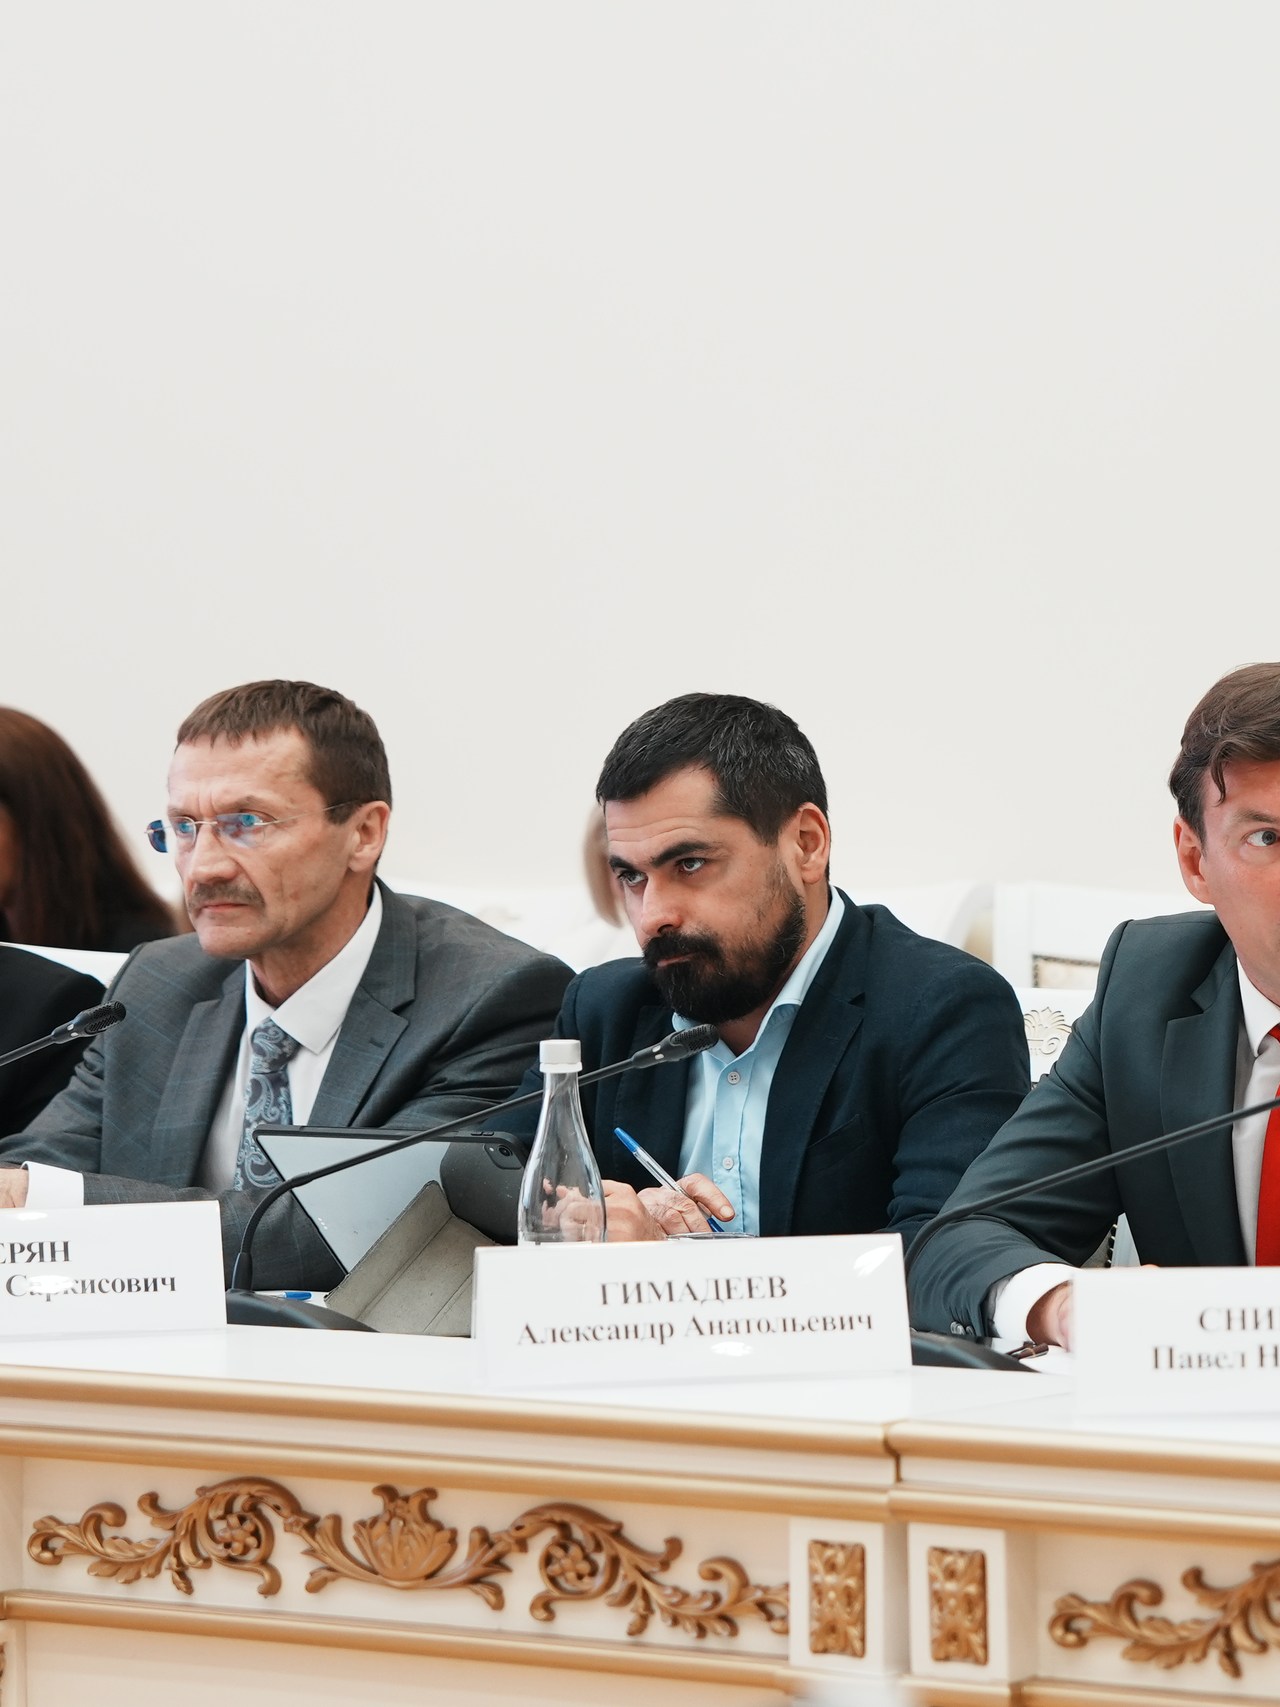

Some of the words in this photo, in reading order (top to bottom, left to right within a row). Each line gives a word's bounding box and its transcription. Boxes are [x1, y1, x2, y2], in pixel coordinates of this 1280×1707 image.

[599, 1275, 788, 1306] ГИМАДЕЕВ
[517, 1320, 675, 1346] Александр
[685, 1312, 874, 1338] Анатольевич
[1152, 1345, 1247, 1371] Павел
